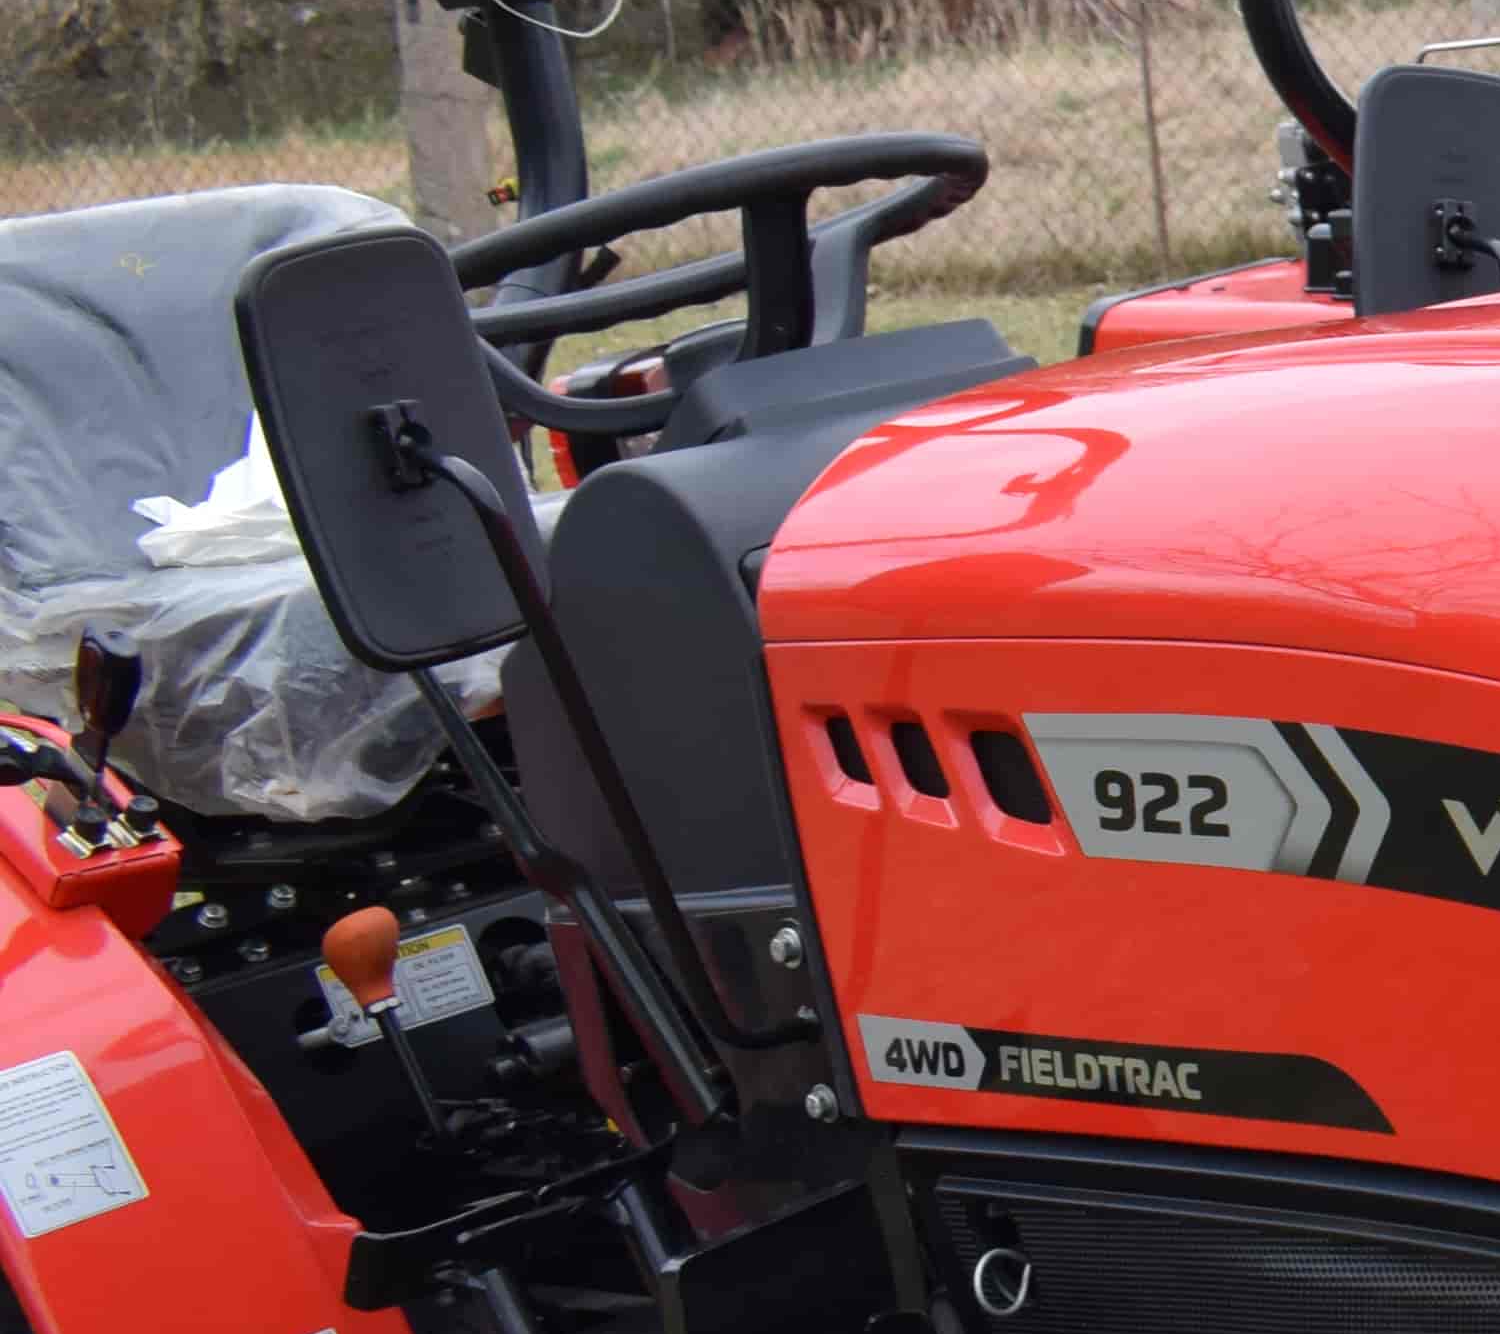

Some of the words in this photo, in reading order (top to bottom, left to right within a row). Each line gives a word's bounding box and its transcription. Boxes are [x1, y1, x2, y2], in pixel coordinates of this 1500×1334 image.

[1093, 769, 1231, 837] 922
[884, 1036, 967, 1078] 4WD
[999, 1044, 1203, 1101] FIELDTRAC
